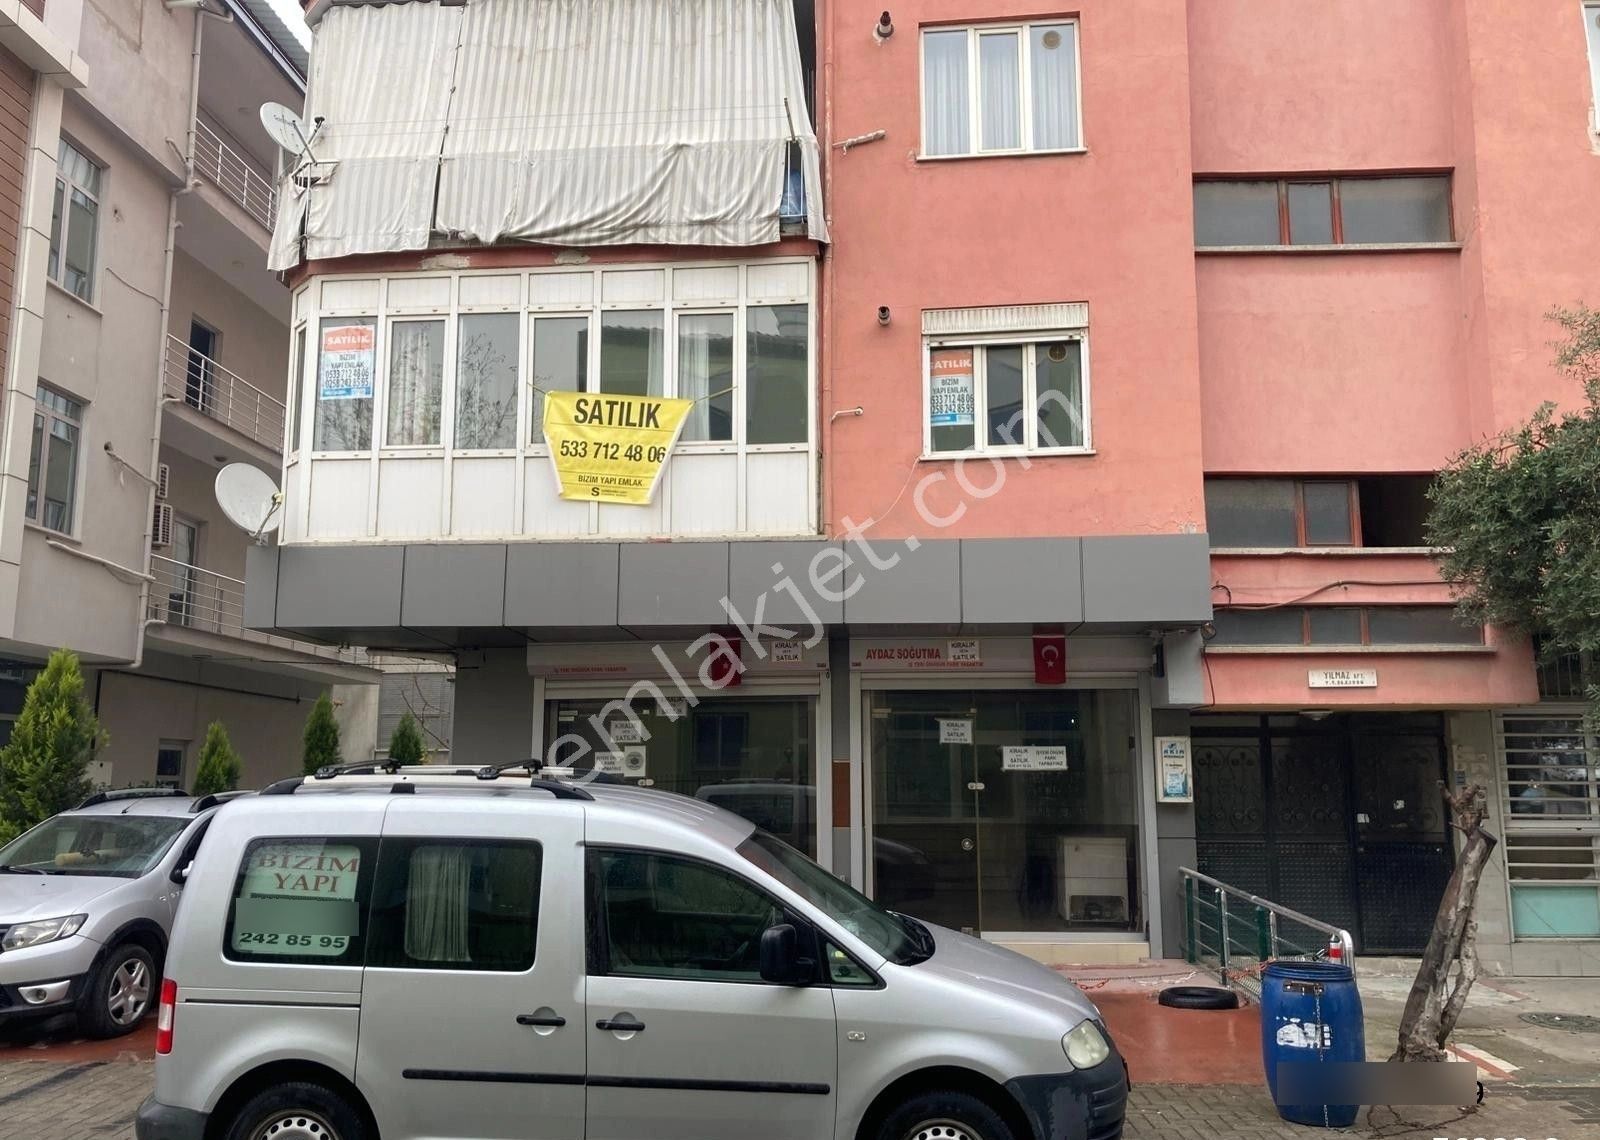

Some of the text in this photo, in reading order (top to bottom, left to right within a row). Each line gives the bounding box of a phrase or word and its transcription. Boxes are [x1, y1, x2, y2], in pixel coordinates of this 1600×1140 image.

[328, 336, 368, 345] SATILIK
[325, 369, 340, 379] 0533
[341, 368, 352, 379] 712
[932, 386, 968, 394] YAPI EMLAK
[943, 393, 956, 404] 712
[956, 393, 966, 403] 48
[574, 398, 661, 429] SATILIK
[943, 403, 956, 413] 242
[560, 439, 667, 463] 533 712 48 06
[578, 474, 643, 487] BİZİM YAPI EMLAK
[591, 486, 600, 497] S
[775, 641, 799, 649] KIRALIK
[951, 640, 976, 649] KIRALIK
[866, 646, 941, 660] AYDAZ SOĞUTMA
[1323, 671, 1350, 680] YILMAZ
[256, 850, 360, 873] BİZİM
[274, 872, 342, 893] YAPI
[239, 931, 346, 949] 242 85 95
